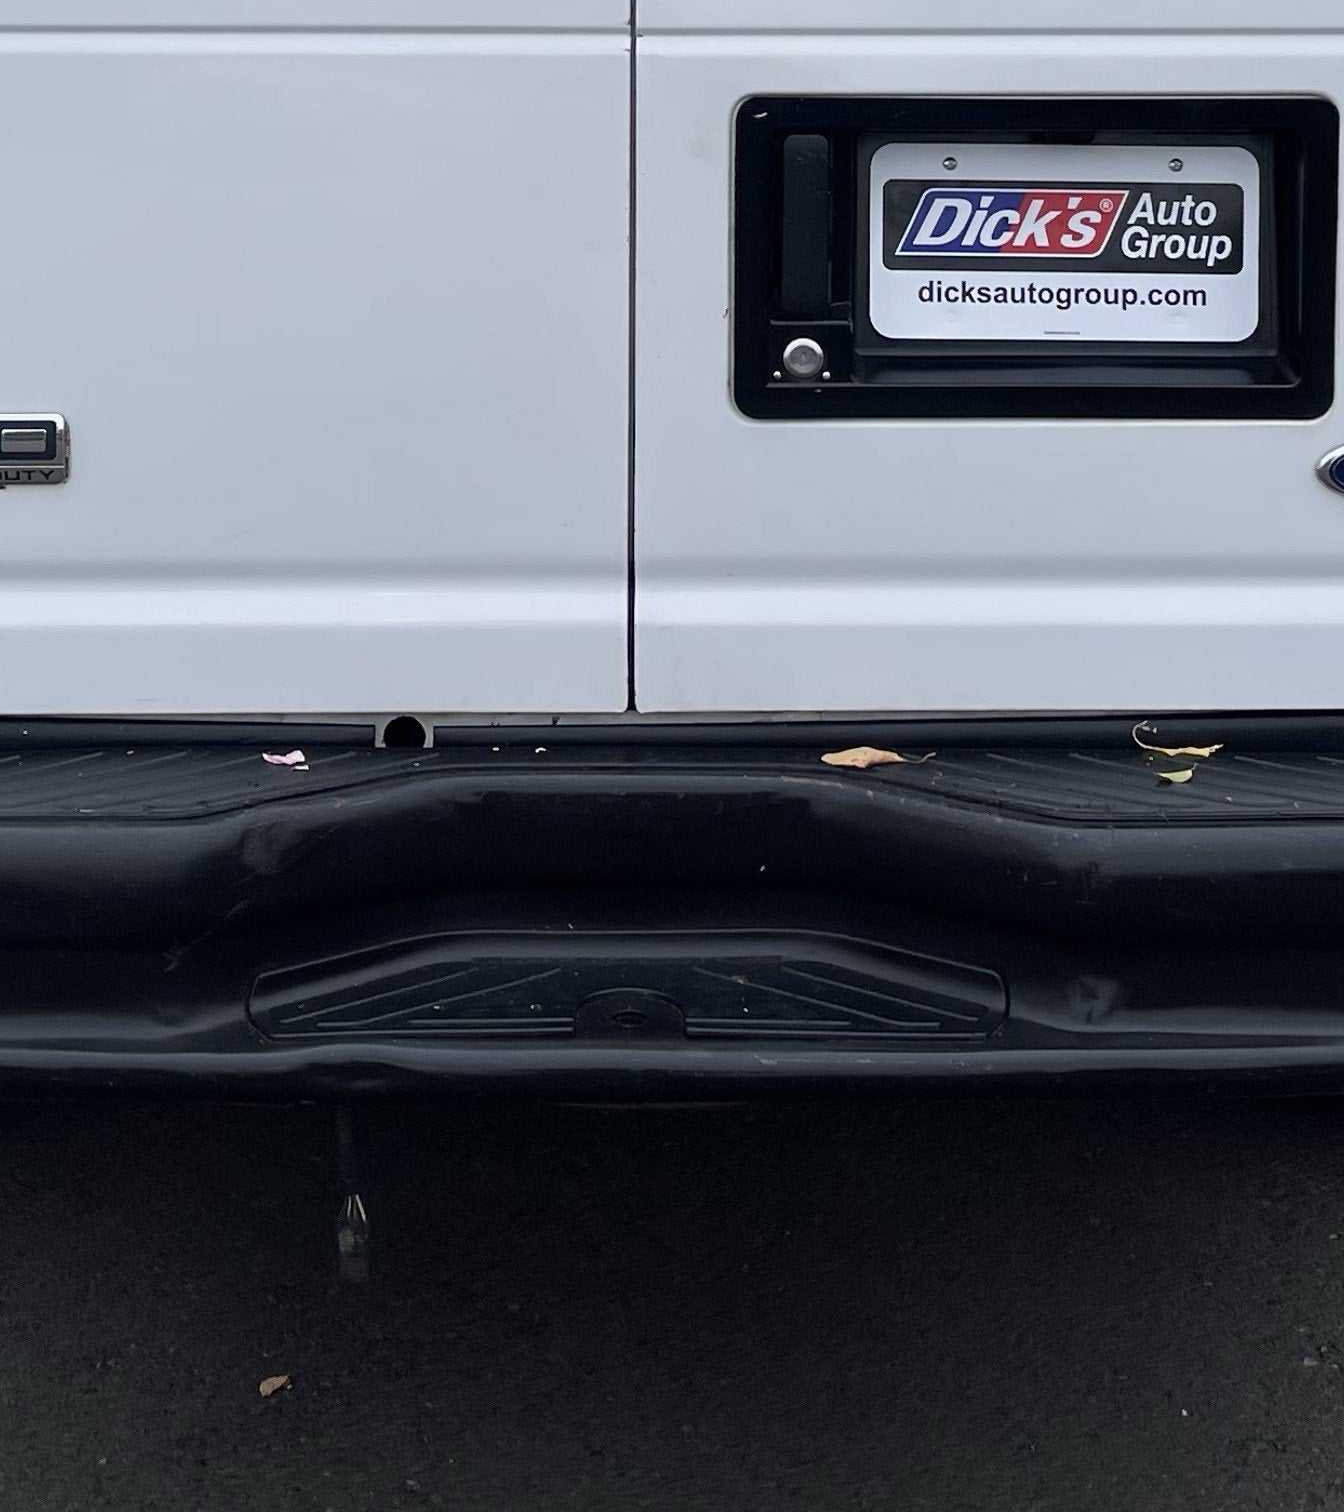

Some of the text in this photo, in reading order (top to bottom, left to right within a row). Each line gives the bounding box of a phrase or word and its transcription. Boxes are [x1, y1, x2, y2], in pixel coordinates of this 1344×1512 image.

[1127, 192, 1217, 228] Auto
[1121, 225, 1233, 267] Group
[917, 280, 1207, 310] dicksautogroup.com
